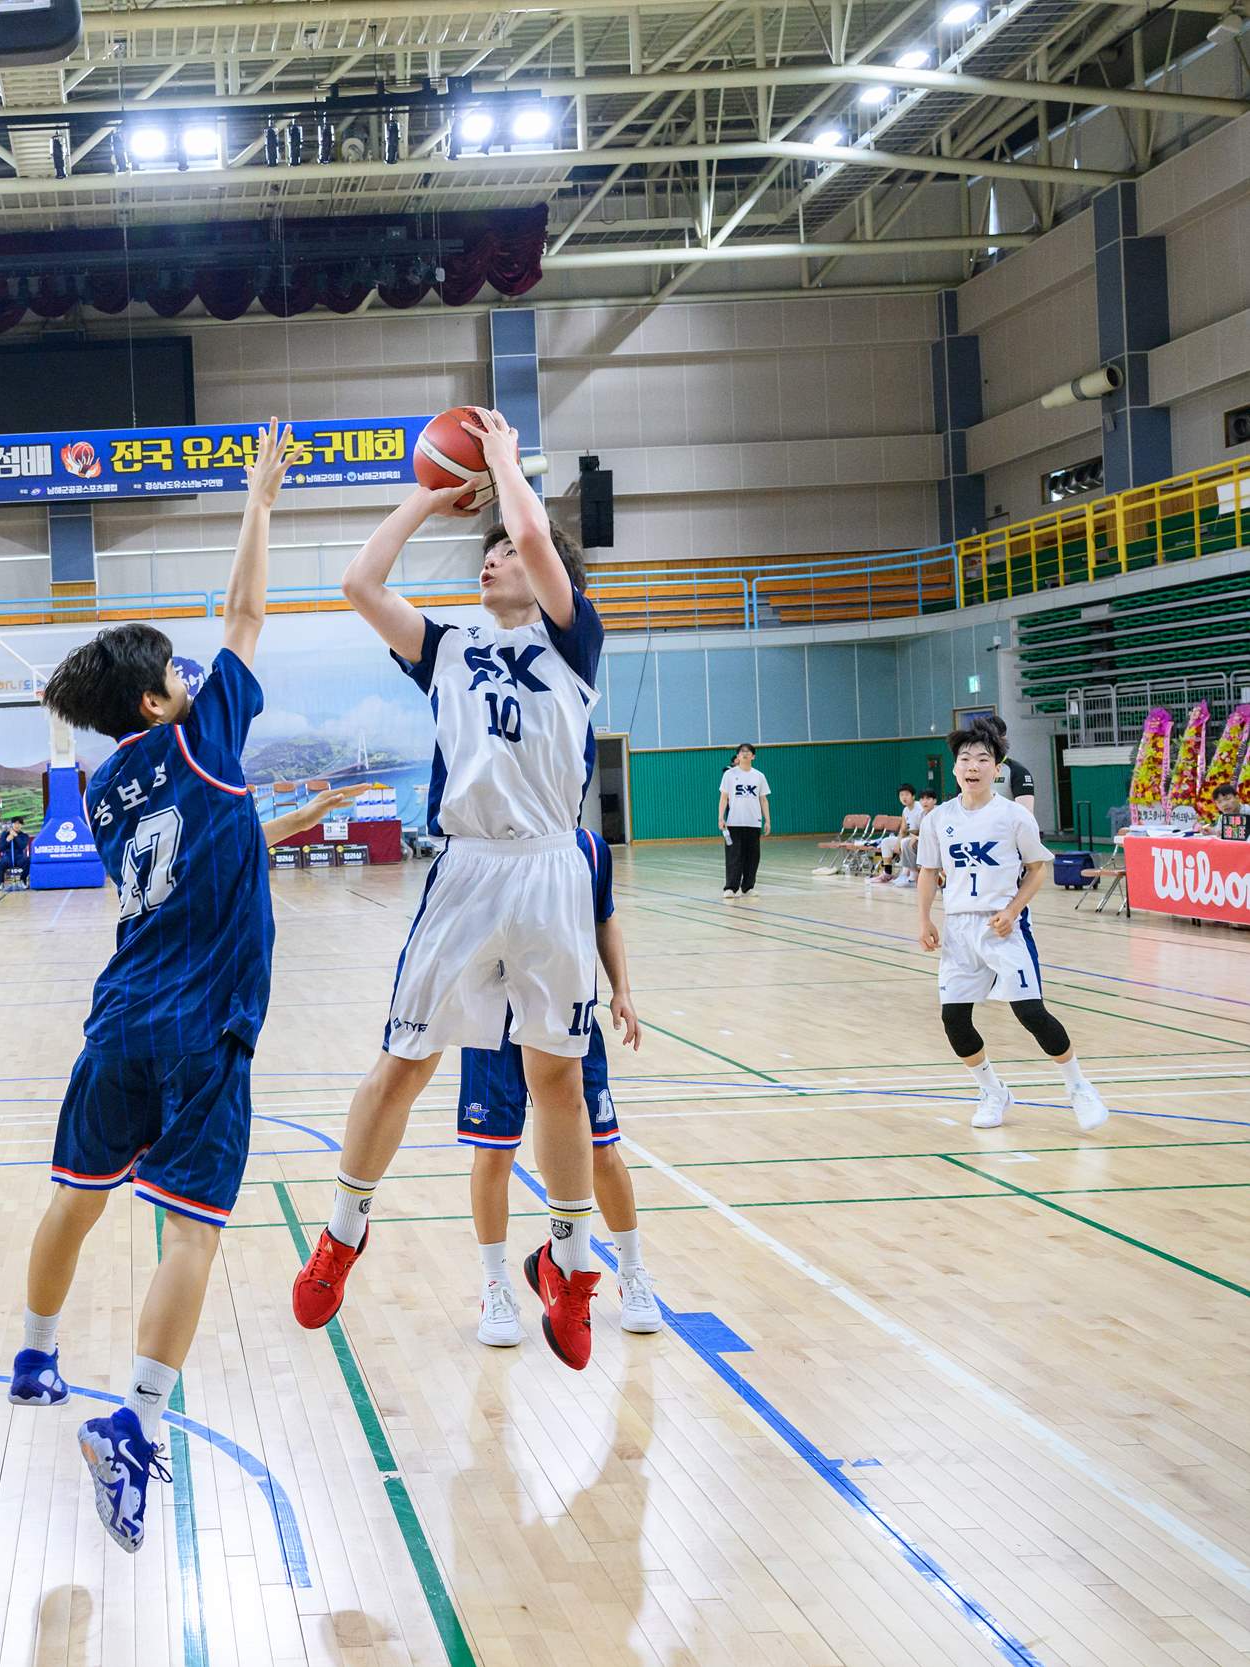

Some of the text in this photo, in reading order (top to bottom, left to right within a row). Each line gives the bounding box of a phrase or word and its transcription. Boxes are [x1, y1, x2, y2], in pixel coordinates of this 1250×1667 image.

[112, 439, 172, 472] 전국
[485, 692, 522, 743] 10
[970, 873, 978, 897] 1
[1152, 846, 1250, 908] Wilso
[1016, 968, 1029, 989] 1
